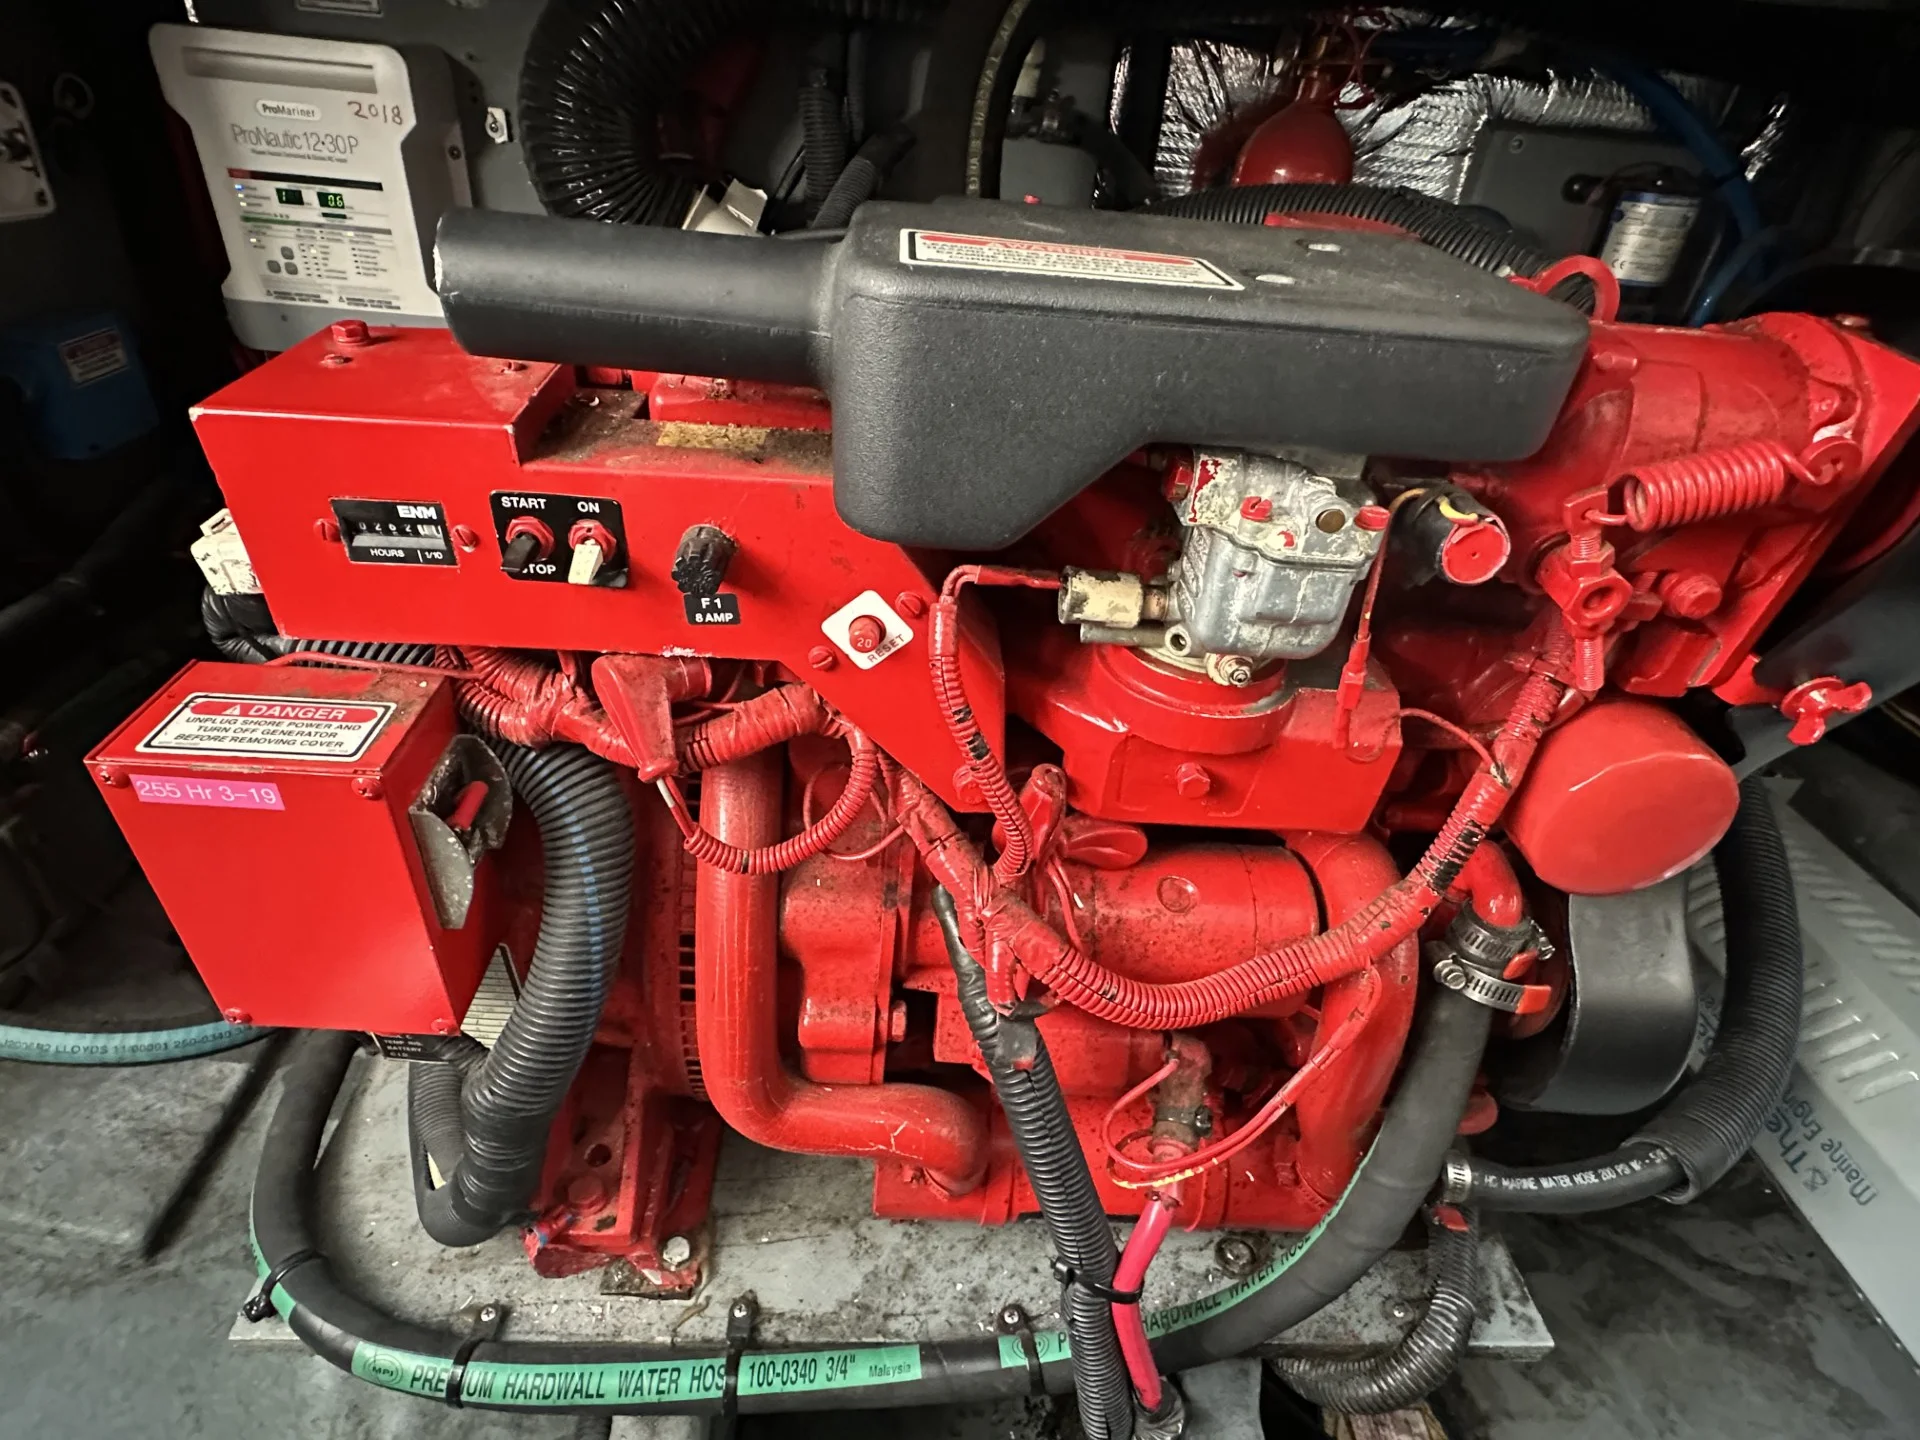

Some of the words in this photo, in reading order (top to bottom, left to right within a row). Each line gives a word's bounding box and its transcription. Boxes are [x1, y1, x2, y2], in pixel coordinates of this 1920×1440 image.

[262, 102, 316, 118] ProMariner
[347, 101, 403, 126] 2018
[501, 496, 547, 510] START
[577, 501, 600, 513] ON
[396, 504, 438, 520] ENM
[370, 547, 405, 558] HOURS
[424, 550, 443, 560] 1/10
[522, 563, 557, 575] TOP
[704, 612, 734, 623] AMP
[857, 637, 873, 649] 20
[866, 632, 906, 664] RESET
[248, 704, 347, 721] DANGER
[185, 716, 238, 726] UNPLUG
[239, 719, 285, 728] SHORE
[286, 721, 333, 731] POWER
[196, 725, 231, 733] TURN
[232, 727, 260, 735] OFF
[261, 728, 338, 739] GENERATOR
[174, 733, 229, 743] BEFORE
[229, 735, 297, 747] REMOVING
[299, 739, 345, 748] COVER
[136, 780, 182, 799] 255
[185, 784, 213, 800] Hr
[55, 1044, 109, 1055] LLOYDS
[1820, 1138, 1878, 1206] Marine
[1501, 1176, 1538, 1190] MARINE
[1538, 1174, 1573, 1189] WATER
[1572, 1170, 1599, 1186] HOSE
[371, 1366, 394, 1377] MPI
[410, 1363, 497, 1399] PREIUM
[502, 1371, 605, 1401] HARDWALL
[618, 1366, 681, 1398] WATER
[689, 1363, 726, 1394] HOS
[749, 1357, 817, 1388] 100-0340
[825, 1354, 856, 1382] 3/4"
[868, 1361, 912, 1379] Malaysia
